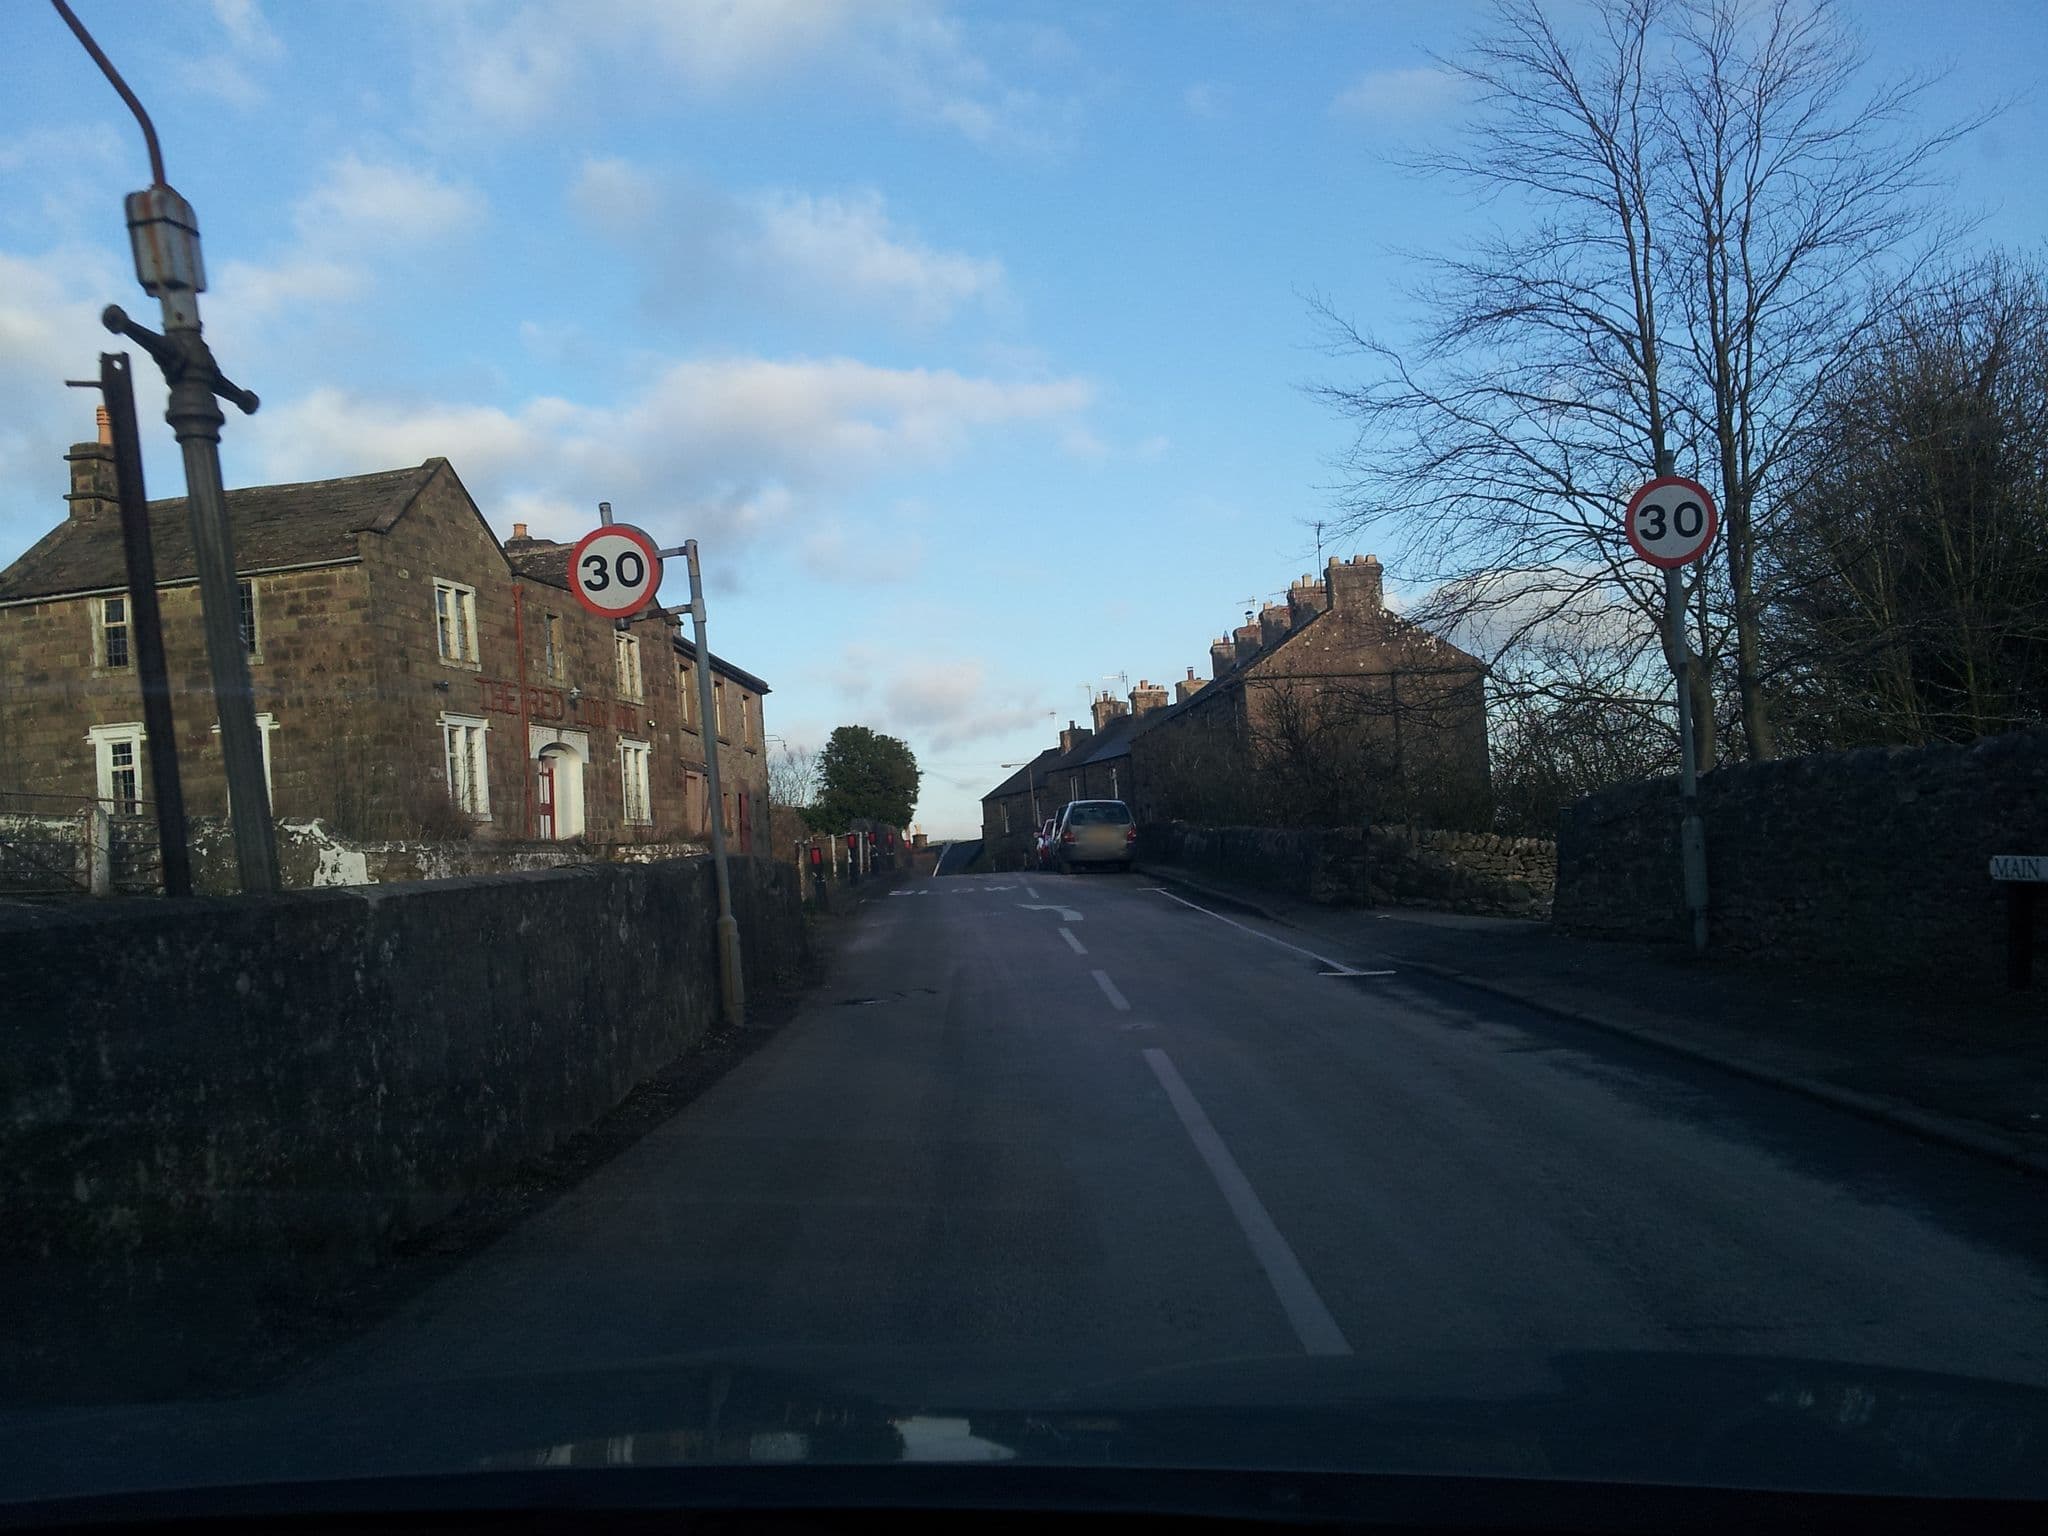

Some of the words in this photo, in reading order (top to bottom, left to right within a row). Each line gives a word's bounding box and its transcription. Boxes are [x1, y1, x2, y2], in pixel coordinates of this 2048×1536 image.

[1638, 501, 1704, 541] 30
[581, 550, 644, 592] 30
[526, 687, 566, 722] RED
[1994, 857, 2040, 880] MAIN
